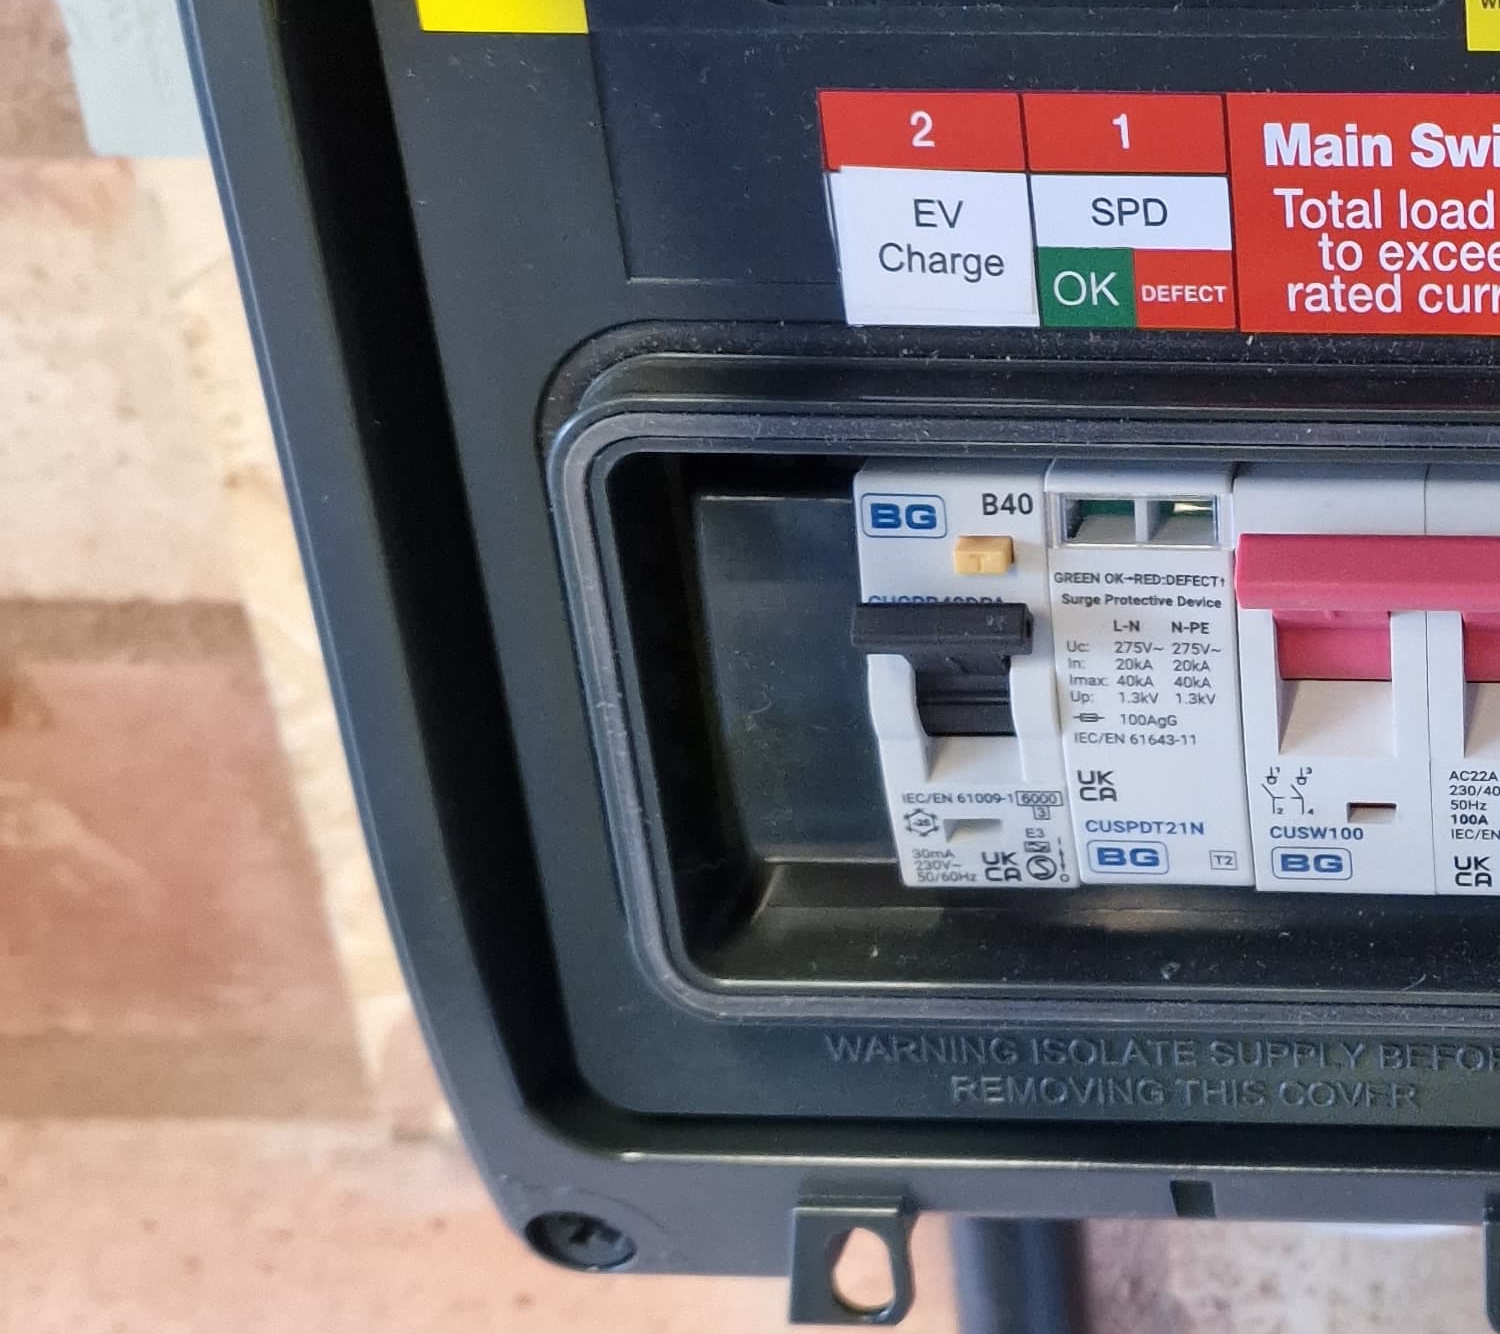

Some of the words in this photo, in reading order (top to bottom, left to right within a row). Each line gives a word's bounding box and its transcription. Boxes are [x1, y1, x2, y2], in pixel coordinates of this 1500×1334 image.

[909, 111, 935, 147] 2
[1113, 113, 1132, 150] 1
[1264, 122, 1392, 167] Main
[912, 199, 964, 229] EV
[1090, 197, 1169, 228] SPD
[1273, 189, 1383, 230] Total
[1399, 189, 1496, 230] load
[1319, 236, 1364, 271] to
[878, 243, 1005, 284] Charge
[1053, 272, 1120, 307] OK
[1142, 285, 1227, 303] DEFECT
[1286, 275, 1401, 315] rated
[981, 493, 1033, 516] B40
[870, 503, 937, 530] BG
[1054, 572, 1100, 584] GREEN
[1062, 594, 1101, 607] Surge
[1104, 594, 1173, 607] Protective
[1177, 596, 1222, 608] Device
[1113, 620, 1140, 632] L-N
[1171, 621, 1210, 634] N-PE
[1115, 658, 1153, 671] 20kA
[1173, 659, 1211, 672] 20kA
[1116, 675, 1154, 687] 40kA
[1174, 676, 1212, 689] 40kA
[1119, 691, 1159, 704] 1.3kV
[1176, 693, 1216, 705] 1.3kV
[1074, 732, 1125, 745] IEC/EN
[1129, 734, 1197, 746] 61643-11
[1077, 770, 1113, 785] UK
[1449, 770, 1498, 782] AC22A
[902, 793, 953, 804] IEC/EN
[957, 793, 1014, 804] 61009-1
[1021, 793, 1058, 804] 6000
[1450, 799, 1487, 811] 50Hz
[1085, 820, 1205, 835] CUSPDT21N
[1450, 814, 1489, 826] 100A
[1270, 826, 1364, 841] CUSW100
[912, 849, 955, 859] 30mA
[981, 851, 1018, 866] UK
[1096, 847, 1160, 867] BG
[1213, 855, 1233, 866] T2
[1280, 853, 1344, 873] BG
[1453, 855, 1491, 871] UK
[918, 872, 977, 883] 50/60Hz
[822, 1033, 1018, 1067] WARNING
[1031, 1036, 1197, 1069] ISOLATE
[1209, 1039, 1368, 1071] SUPPLY
[950, 1074, 1165, 1107] REMOVING
[1175, 1077, 1266, 1107] THIS
[1278, 1079, 1422, 1109] COVER
